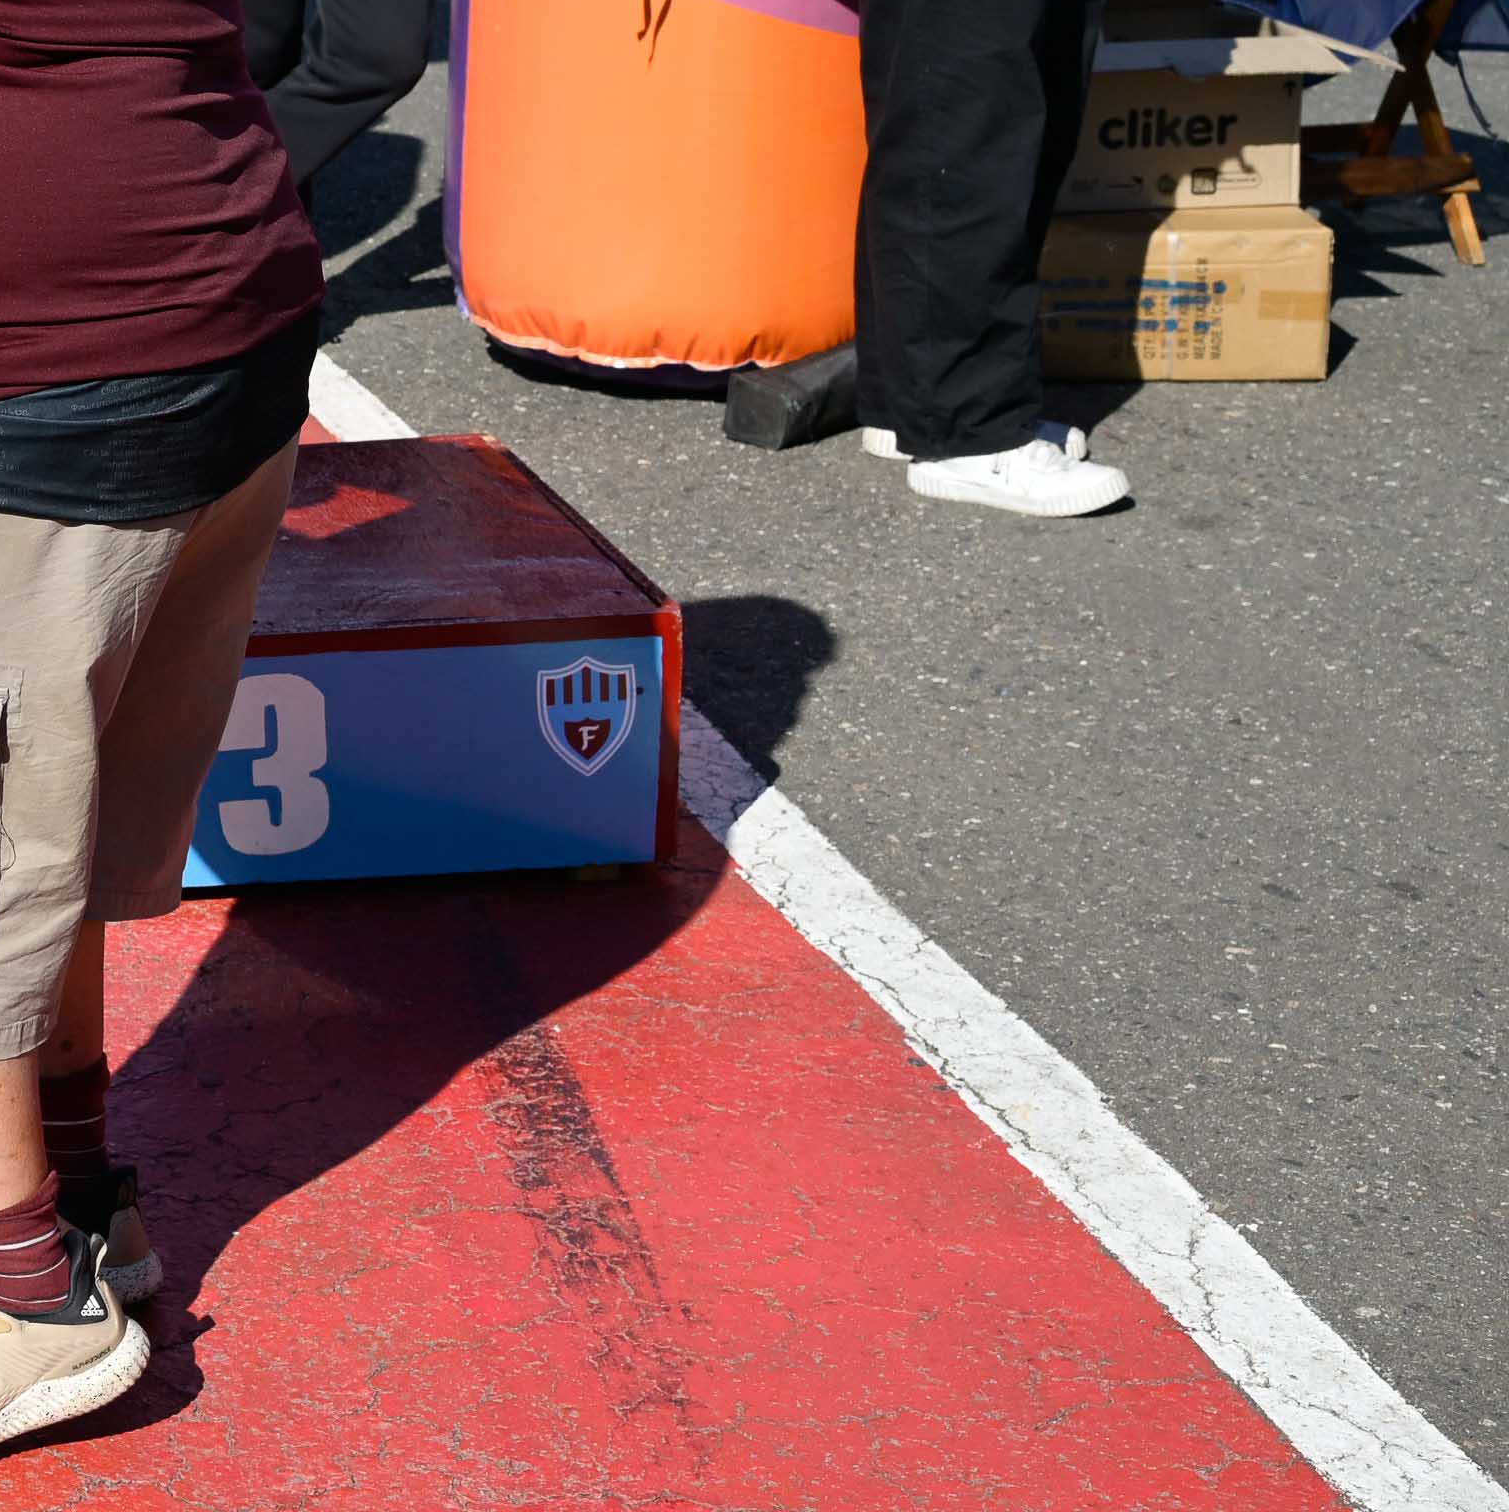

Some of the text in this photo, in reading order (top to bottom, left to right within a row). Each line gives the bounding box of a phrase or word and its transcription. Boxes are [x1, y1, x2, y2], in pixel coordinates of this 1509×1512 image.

[1098, 108, 1238, 149] cliker
[217, 673, 330, 856] 3
[80, 1308, 105, 1317] adidas
